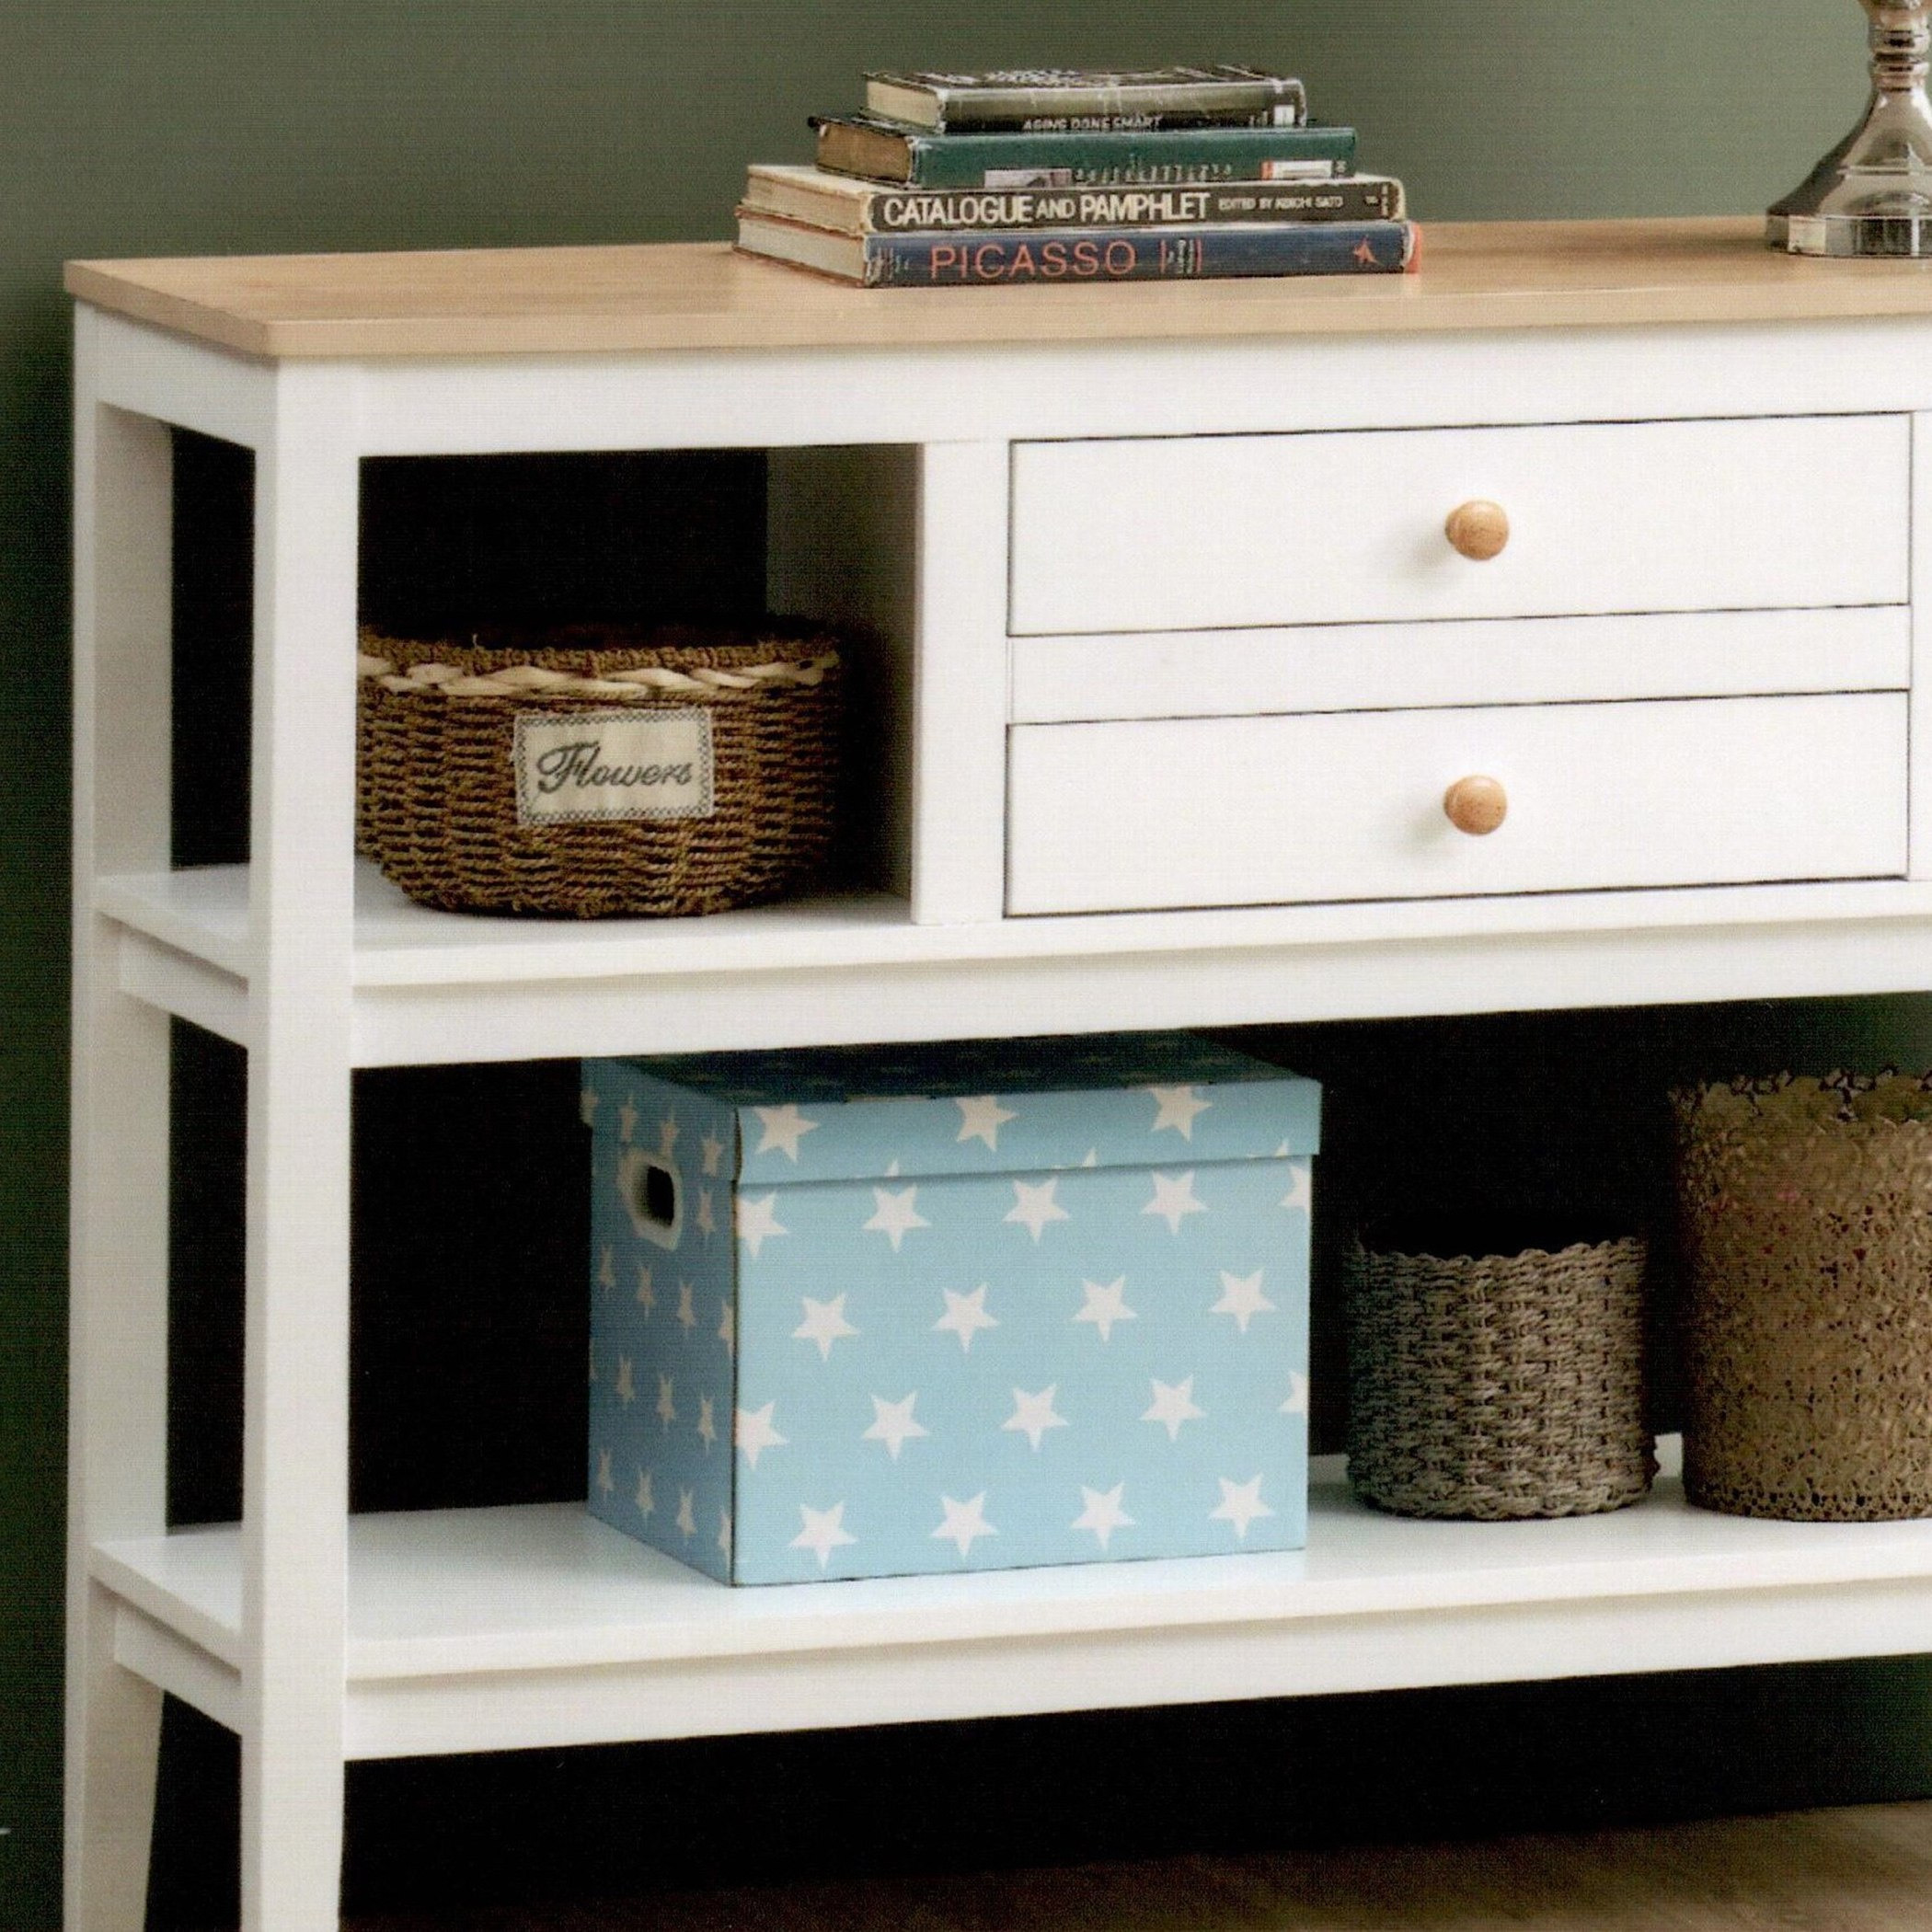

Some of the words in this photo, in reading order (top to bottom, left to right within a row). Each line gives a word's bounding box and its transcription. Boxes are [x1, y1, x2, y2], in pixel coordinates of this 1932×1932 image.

[883, 195, 1033, 226] CATALOGUE
[1036, 197, 1075, 220] AND
[1080, 191, 1211, 223] PAMPHLET
[1259, 197, 1273, 210] BY
[930, 238, 1137, 279] PICASSO
[536, 740, 693, 794] Flowers
